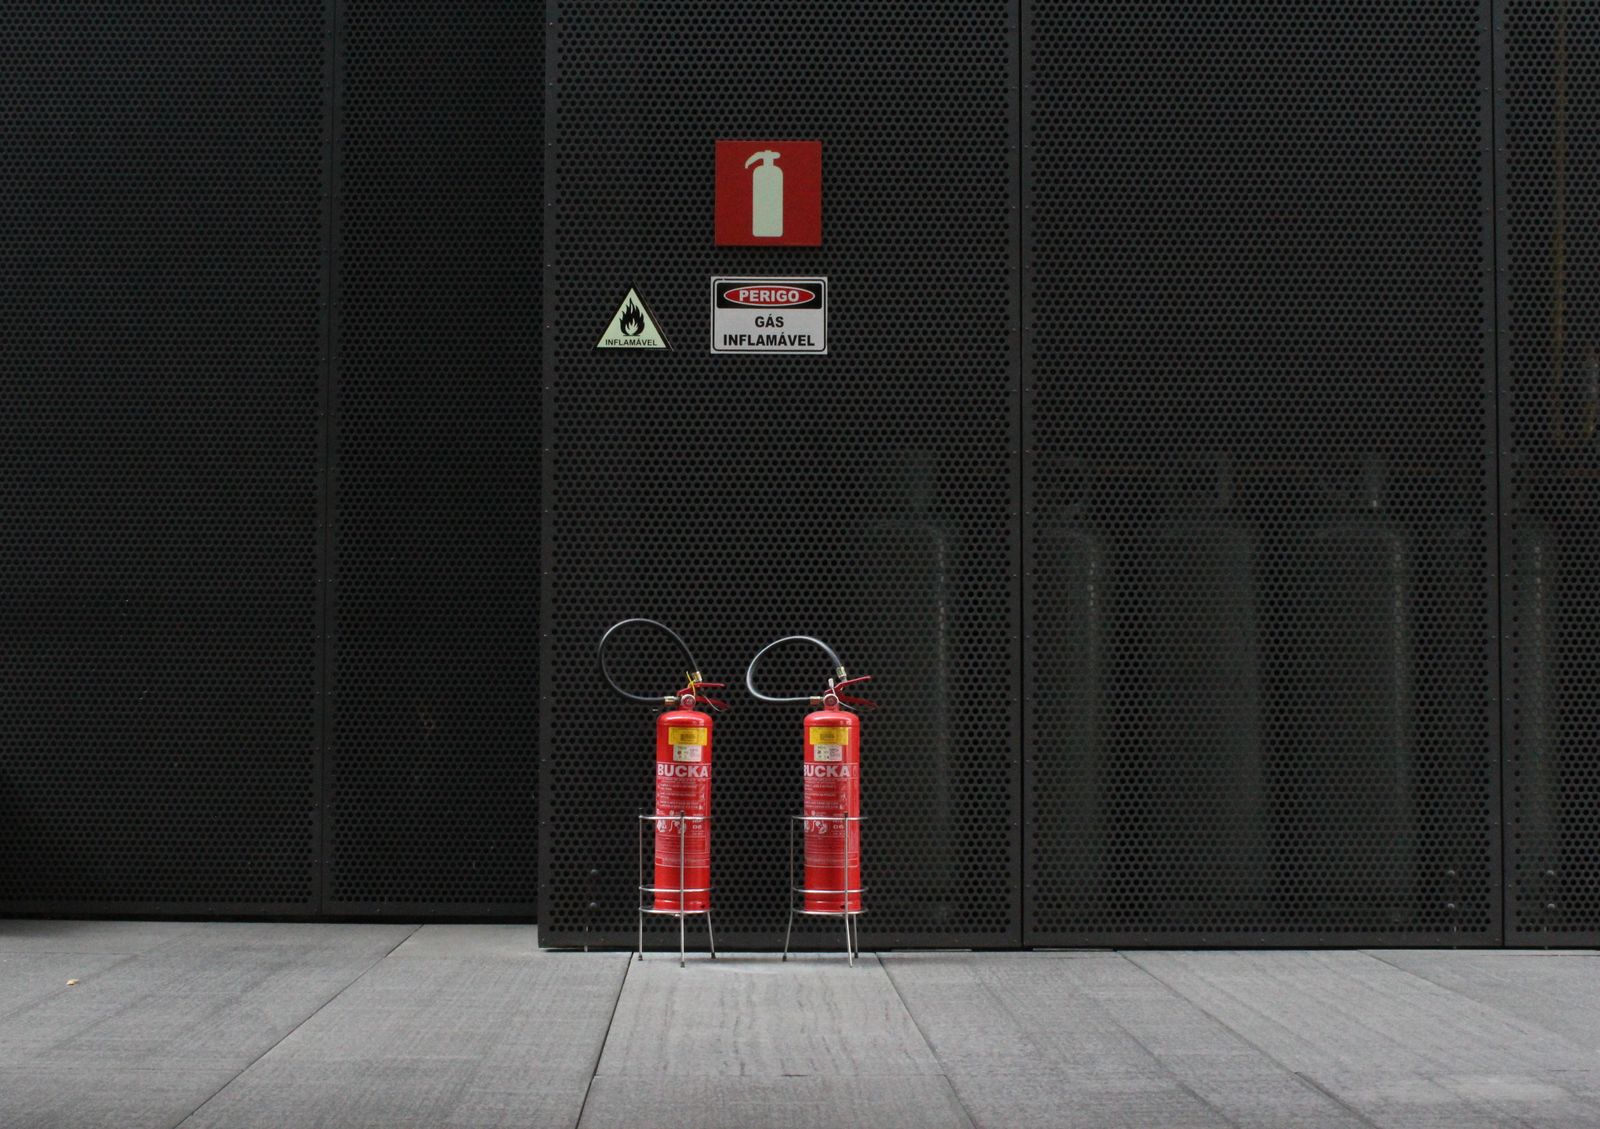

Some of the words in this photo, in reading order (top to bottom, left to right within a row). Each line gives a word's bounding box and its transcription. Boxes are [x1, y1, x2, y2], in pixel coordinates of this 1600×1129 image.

[739, 290, 800, 302] PERIGO
[755, 314, 784, 328] GÁS
[605, 338, 658, 346] INFLAMÁVEL
[723, 332, 815, 346] INFLAMÁVEL
[657, 763, 709, 778] BUCKA
